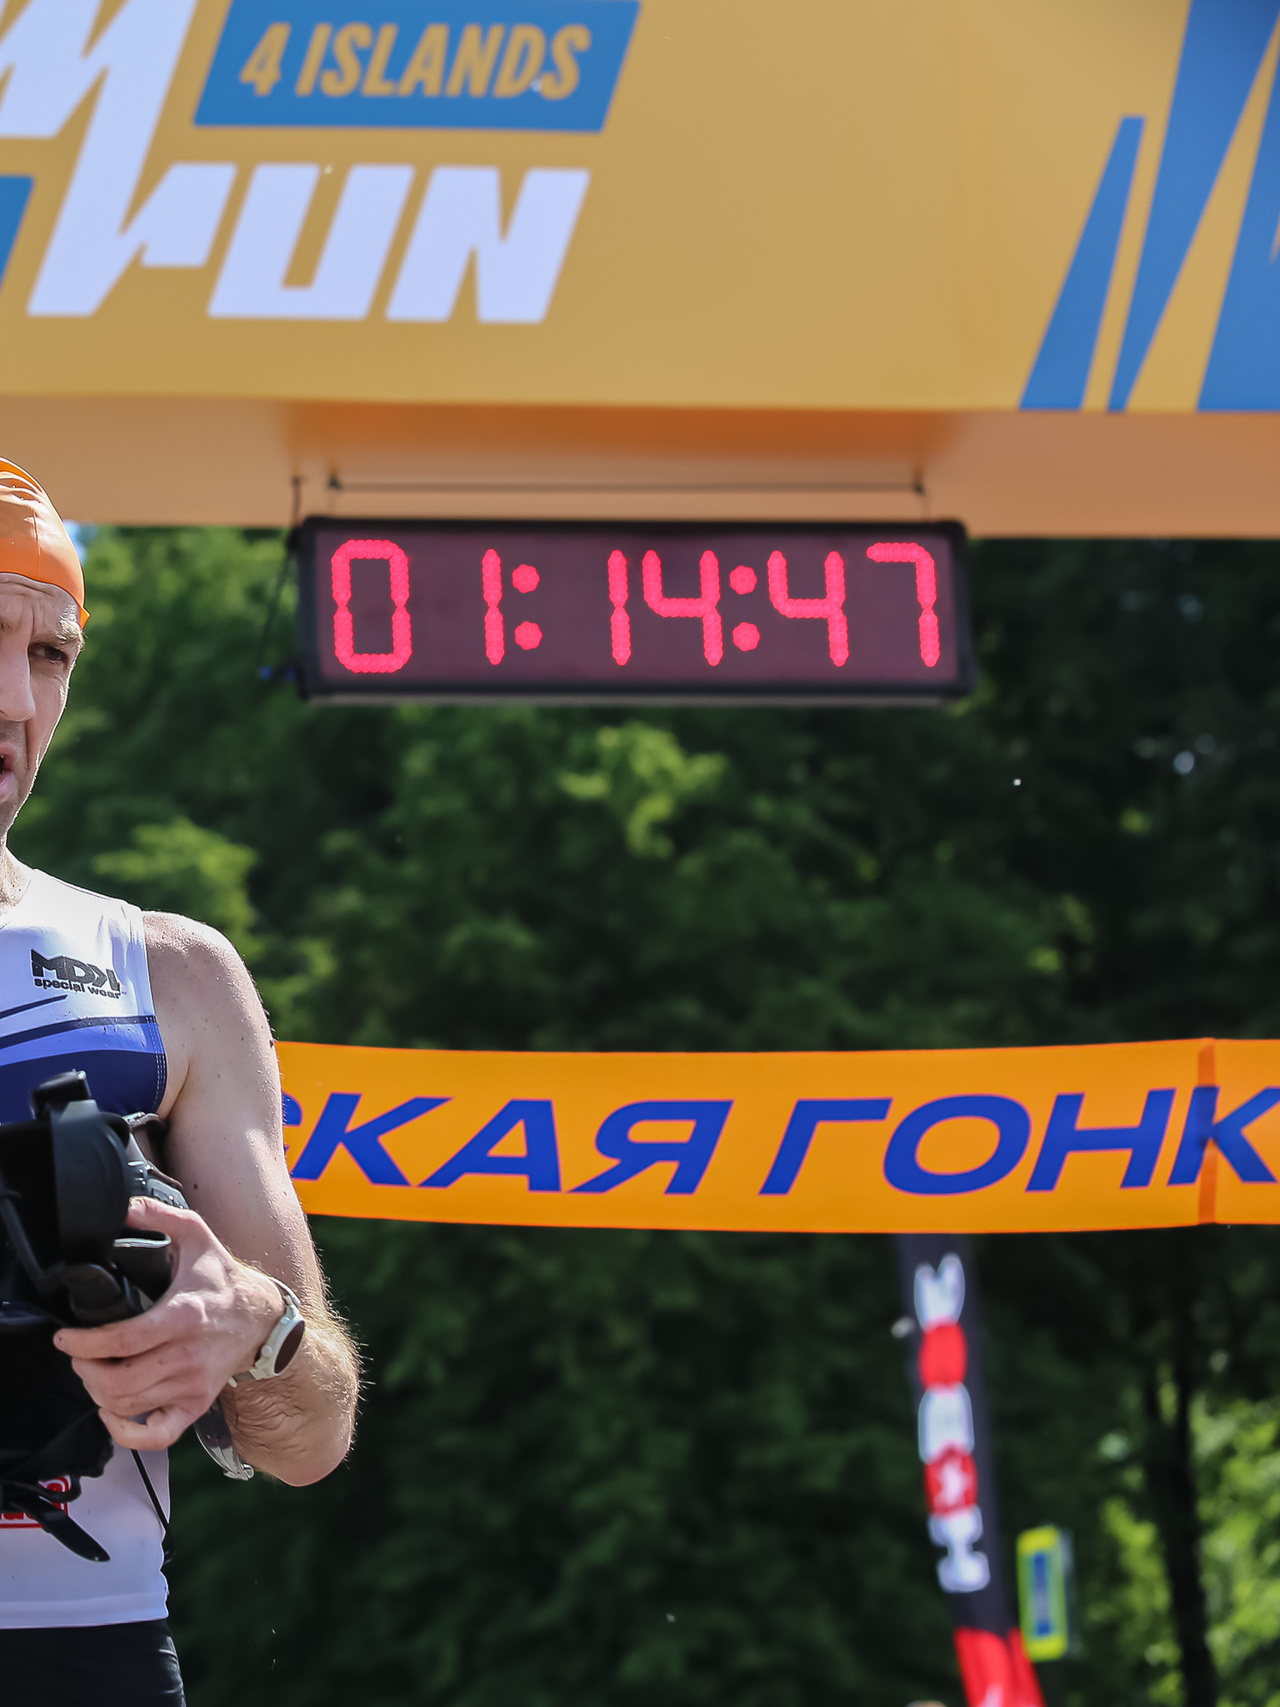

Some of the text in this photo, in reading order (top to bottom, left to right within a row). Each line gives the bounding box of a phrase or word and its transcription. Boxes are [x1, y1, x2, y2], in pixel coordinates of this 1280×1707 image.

[238, 22, 592, 100] 4 ISLANDS
[34, 977, 86, 993] special
[757, 1086, 1280, 1195] ГОНК
